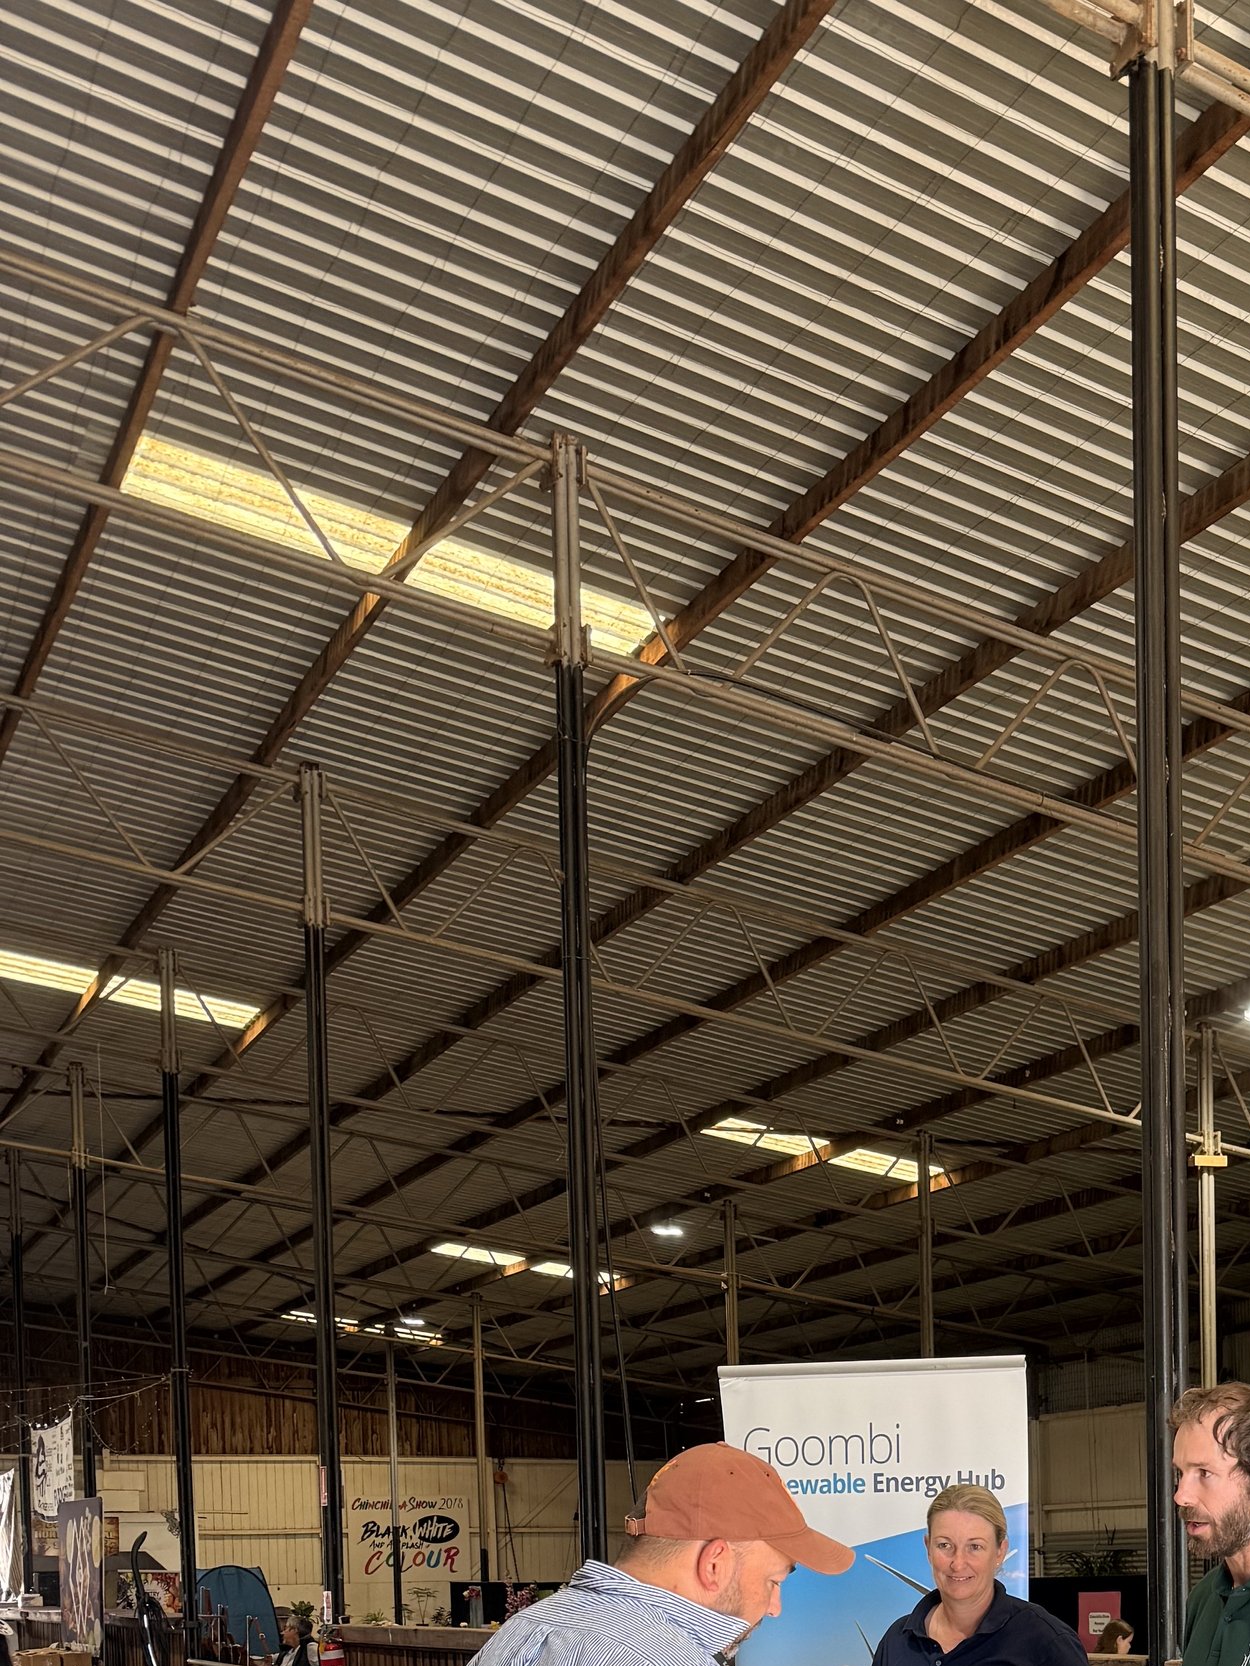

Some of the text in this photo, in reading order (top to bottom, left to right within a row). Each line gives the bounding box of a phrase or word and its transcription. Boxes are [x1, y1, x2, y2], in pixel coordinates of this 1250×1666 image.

[744, 1422, 900, 1467] Goombi
[786, 1472, 866, 1495] ewable
[873, 1473, 951, 1499] Energy
[357, 1516, 455, 1545] BLAK, WHITE
[401, 1540, 424, 1550] PLASH
